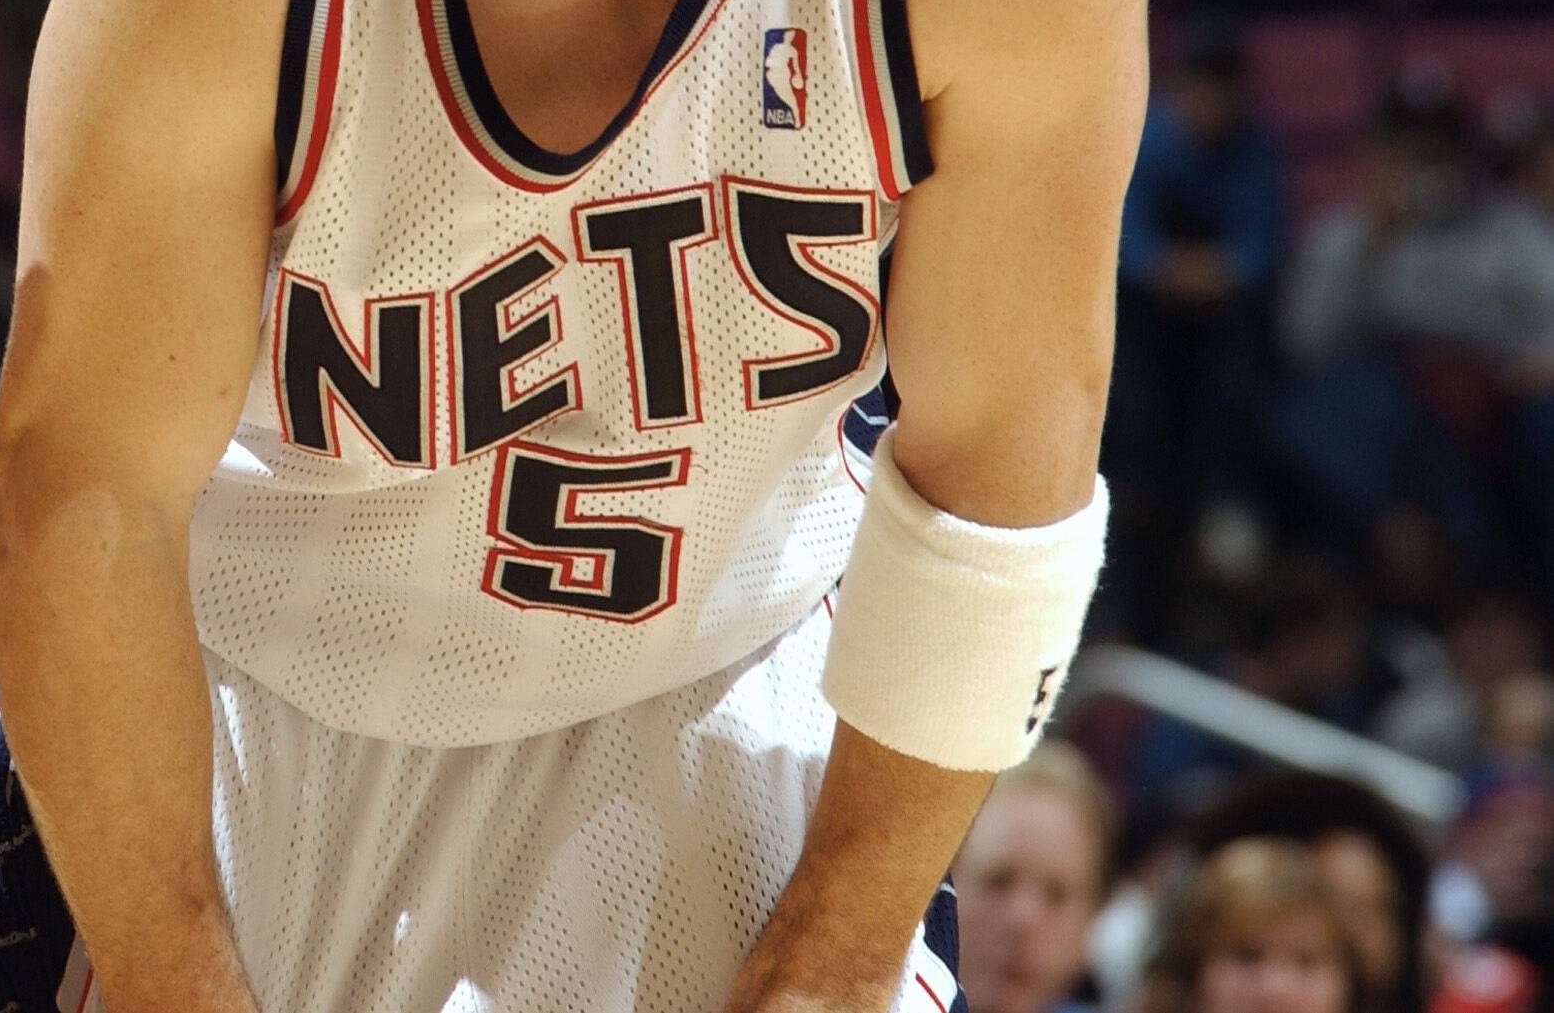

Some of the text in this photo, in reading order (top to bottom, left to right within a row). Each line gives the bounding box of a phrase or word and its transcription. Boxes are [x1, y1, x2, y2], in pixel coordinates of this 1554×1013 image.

[766, 108, 795, 125] NBA
[272, 174, 881, 470] NETS
[481, 437, 692, 625] 5
